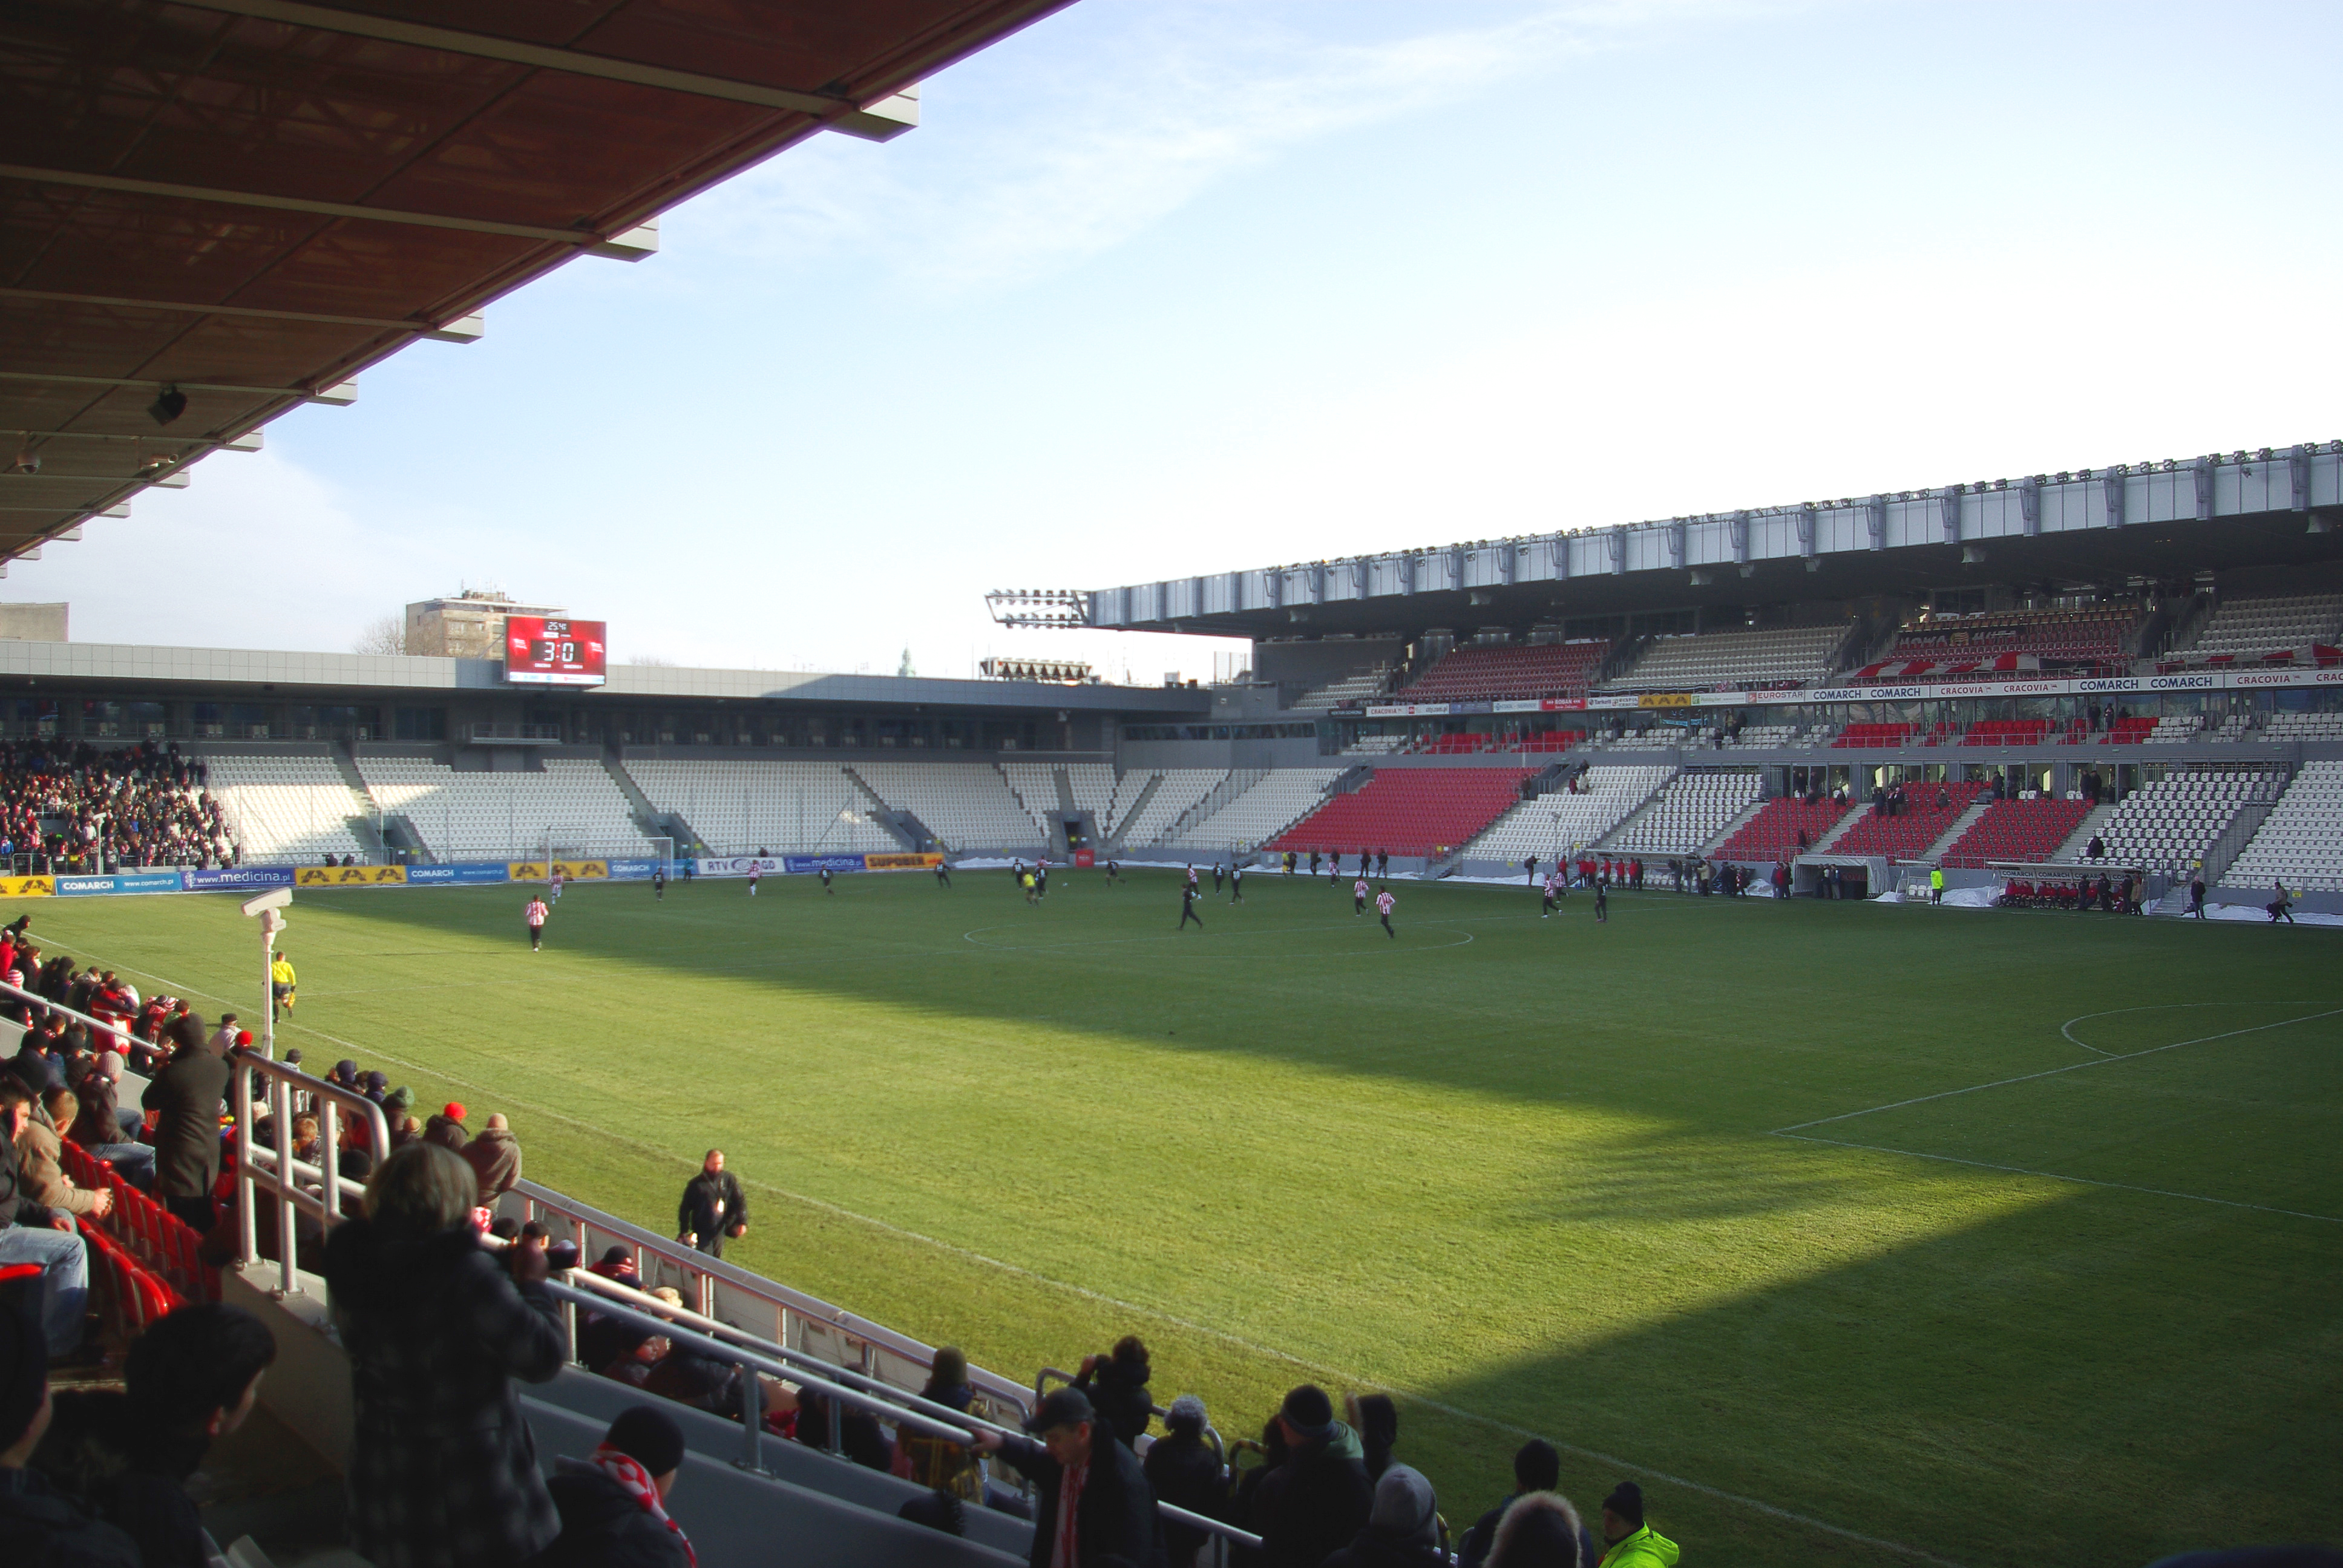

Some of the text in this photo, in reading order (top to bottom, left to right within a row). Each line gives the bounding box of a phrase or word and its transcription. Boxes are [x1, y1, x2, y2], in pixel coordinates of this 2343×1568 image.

[2080, 677, 2212, 690] COMARCH COMARCH
[2237, 673, 2343, 684] CRACOVIA CRAC
[1813, 687, 1921, 700] COMARCH COMARCH
[1941, 684, 2048, 694] CRACOVIA CRACOVIA
[197, 872, 290, 884] www.medicina.pl
[63, 879, 174, 890] COMARCH www.comarch.pl
